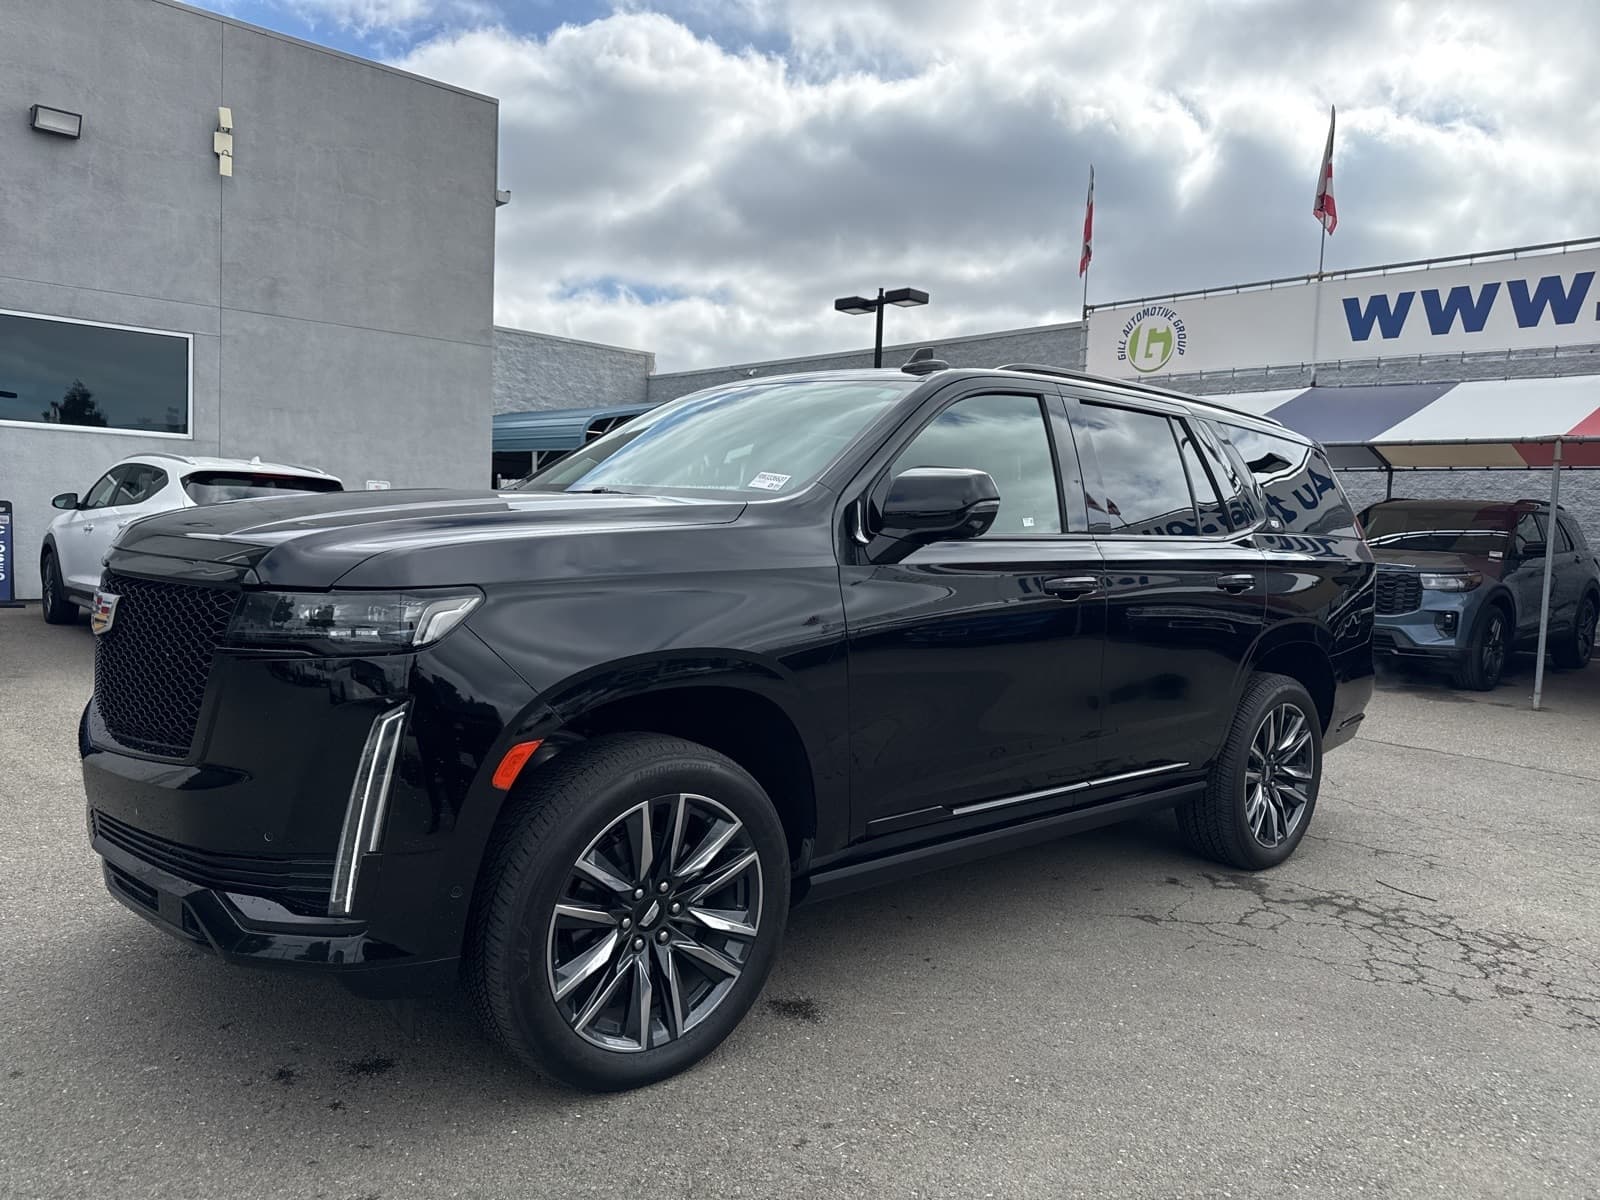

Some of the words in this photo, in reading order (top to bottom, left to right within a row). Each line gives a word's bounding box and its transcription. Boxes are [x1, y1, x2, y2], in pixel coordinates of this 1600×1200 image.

[1117, 339, 1127, 361] GILL
[1122, 306, 1177, 338] AUTOMOTIVE
[1172, 319, 1187, 356] GROUP
